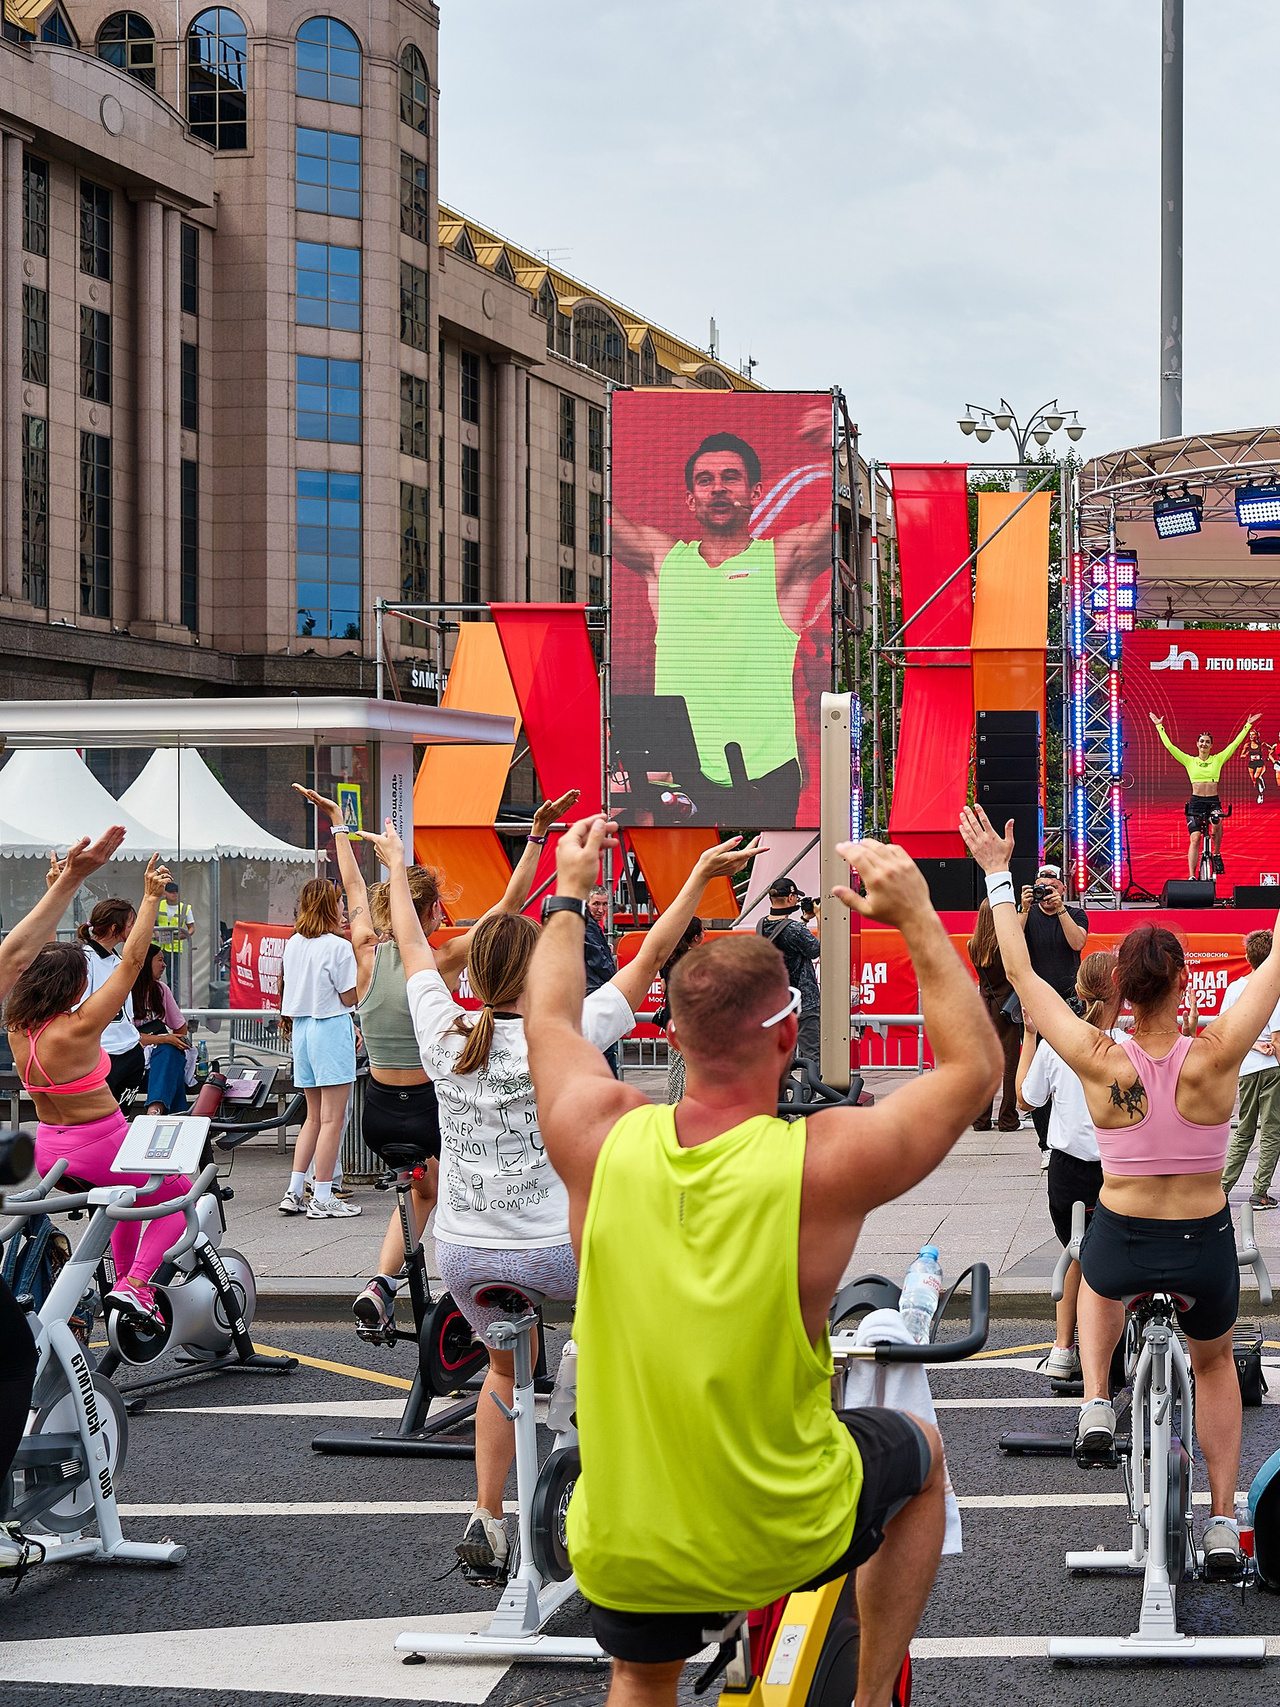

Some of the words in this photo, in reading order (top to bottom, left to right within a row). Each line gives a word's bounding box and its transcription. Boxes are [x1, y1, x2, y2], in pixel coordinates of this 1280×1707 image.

[1205, 658, 1234, 671] ЛЕТО
[1236, 658, 1274, 671] ПОБЕД
[490, 1187, 550, 1211] COMPAGNIE
[506, 1178, 540, 1196] BONNE
[203, 1244, 231, 1293] GYMTOUCH
[234, 1317, 247, 1335] 007
[70, 1353, 102, 1437] GYMTOUCH
[98, 1466, 113, 1500] 008
